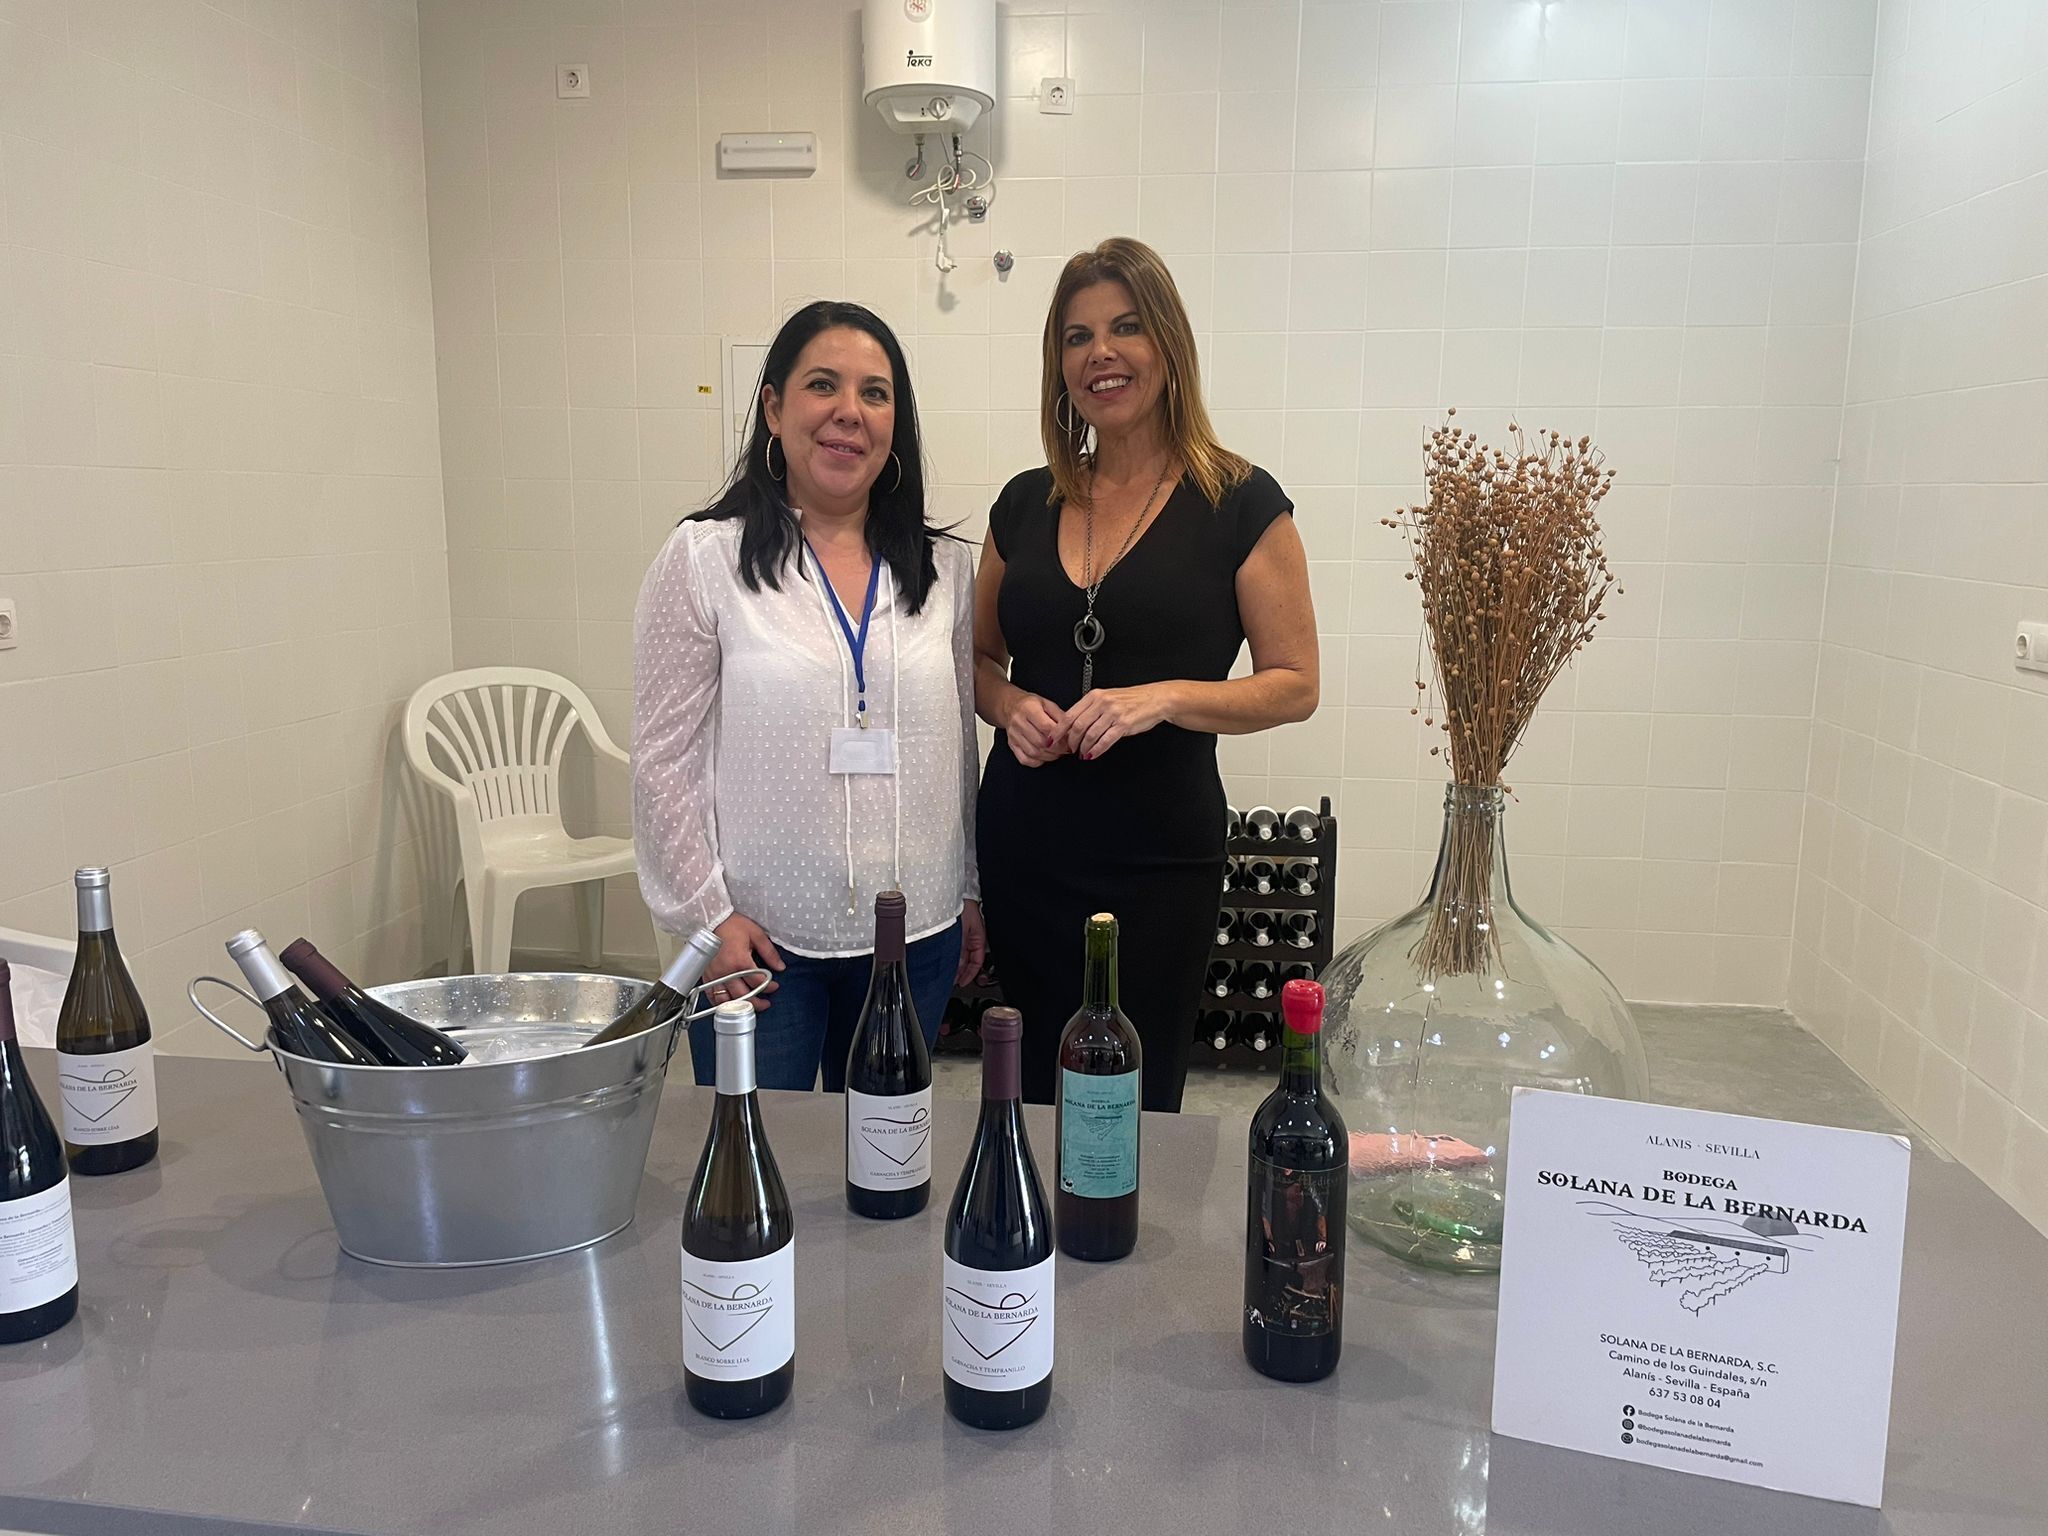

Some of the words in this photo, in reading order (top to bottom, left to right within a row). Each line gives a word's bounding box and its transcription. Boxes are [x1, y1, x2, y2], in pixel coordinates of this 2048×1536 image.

[98, 1079, 137, 1091] BERNARDA
[861, 1125, 887, 1134] SOLANA
[1704, 1142, 1761, 1160] SEVILLA
[1662, 1169, 1738, 1190] BODEGA
[1537, 1170, 1635, 1199] SOLANA
[1642, 1185, 1676, 1205] DE
[1684, 1192, 1716, 1212] LA
[1724, 1197, 1869, 1234] BERNARDA
[701, 1300, 713, 1309] DE
[714, 1303, 725, 1311] LA
[726, 1296, 773, 1311] BERNARDA
[967, 1308, 980, 1318] DE
[981, 1311, 992, 1319] LA
[993, 1305, 1039, 1320] BERNARDA
[1599, 1333, 1648, 1351] SOLANA
[1650, 1342, 1667, 1354] DE
[1669, 1346, 1685, 1357] LA
[1686, 1349, 1755, 1371] BERNARDA,
[1756, 1361, 1780, 1375] S.C.
[984, 1365, 1026, 1374] TEMPRANILLO
[1608, 1350, 1651, 1366] Camino
[1653, 1358, 1668, 1369] de
[1670, 1360, 1686, 1373] los
[1688, 1364, 1748, 1385] Guindales,
[1749, 1376, 1768, 1388] s/n
[1622, 1367, 1656, 1382] Alanís
[1665, 1375, 1700, 1390] Sevilla
[1709, 1383, 1751, 1399] España
[1648, 1387, 1670, 1399] 637
[1672, 1391, 1687, 1402] 53
[1689, 1394, 1704, 1405] 08
[1706, 1397, 1721, 1408] 04
[1637, 1409, 1663, 1420] Bodega
[1664, 1414, 1686, 1424] Solana
[1687, 1418, 1696, 1426] de
[1704, 1422, 1735, 1433] Bernarda
[1637, 1423, 1732, 1447] @bodegasolanadelabernarda
[1636, 1437, 1764, 1468] bodegasolanadelabernarda@gmail.com
